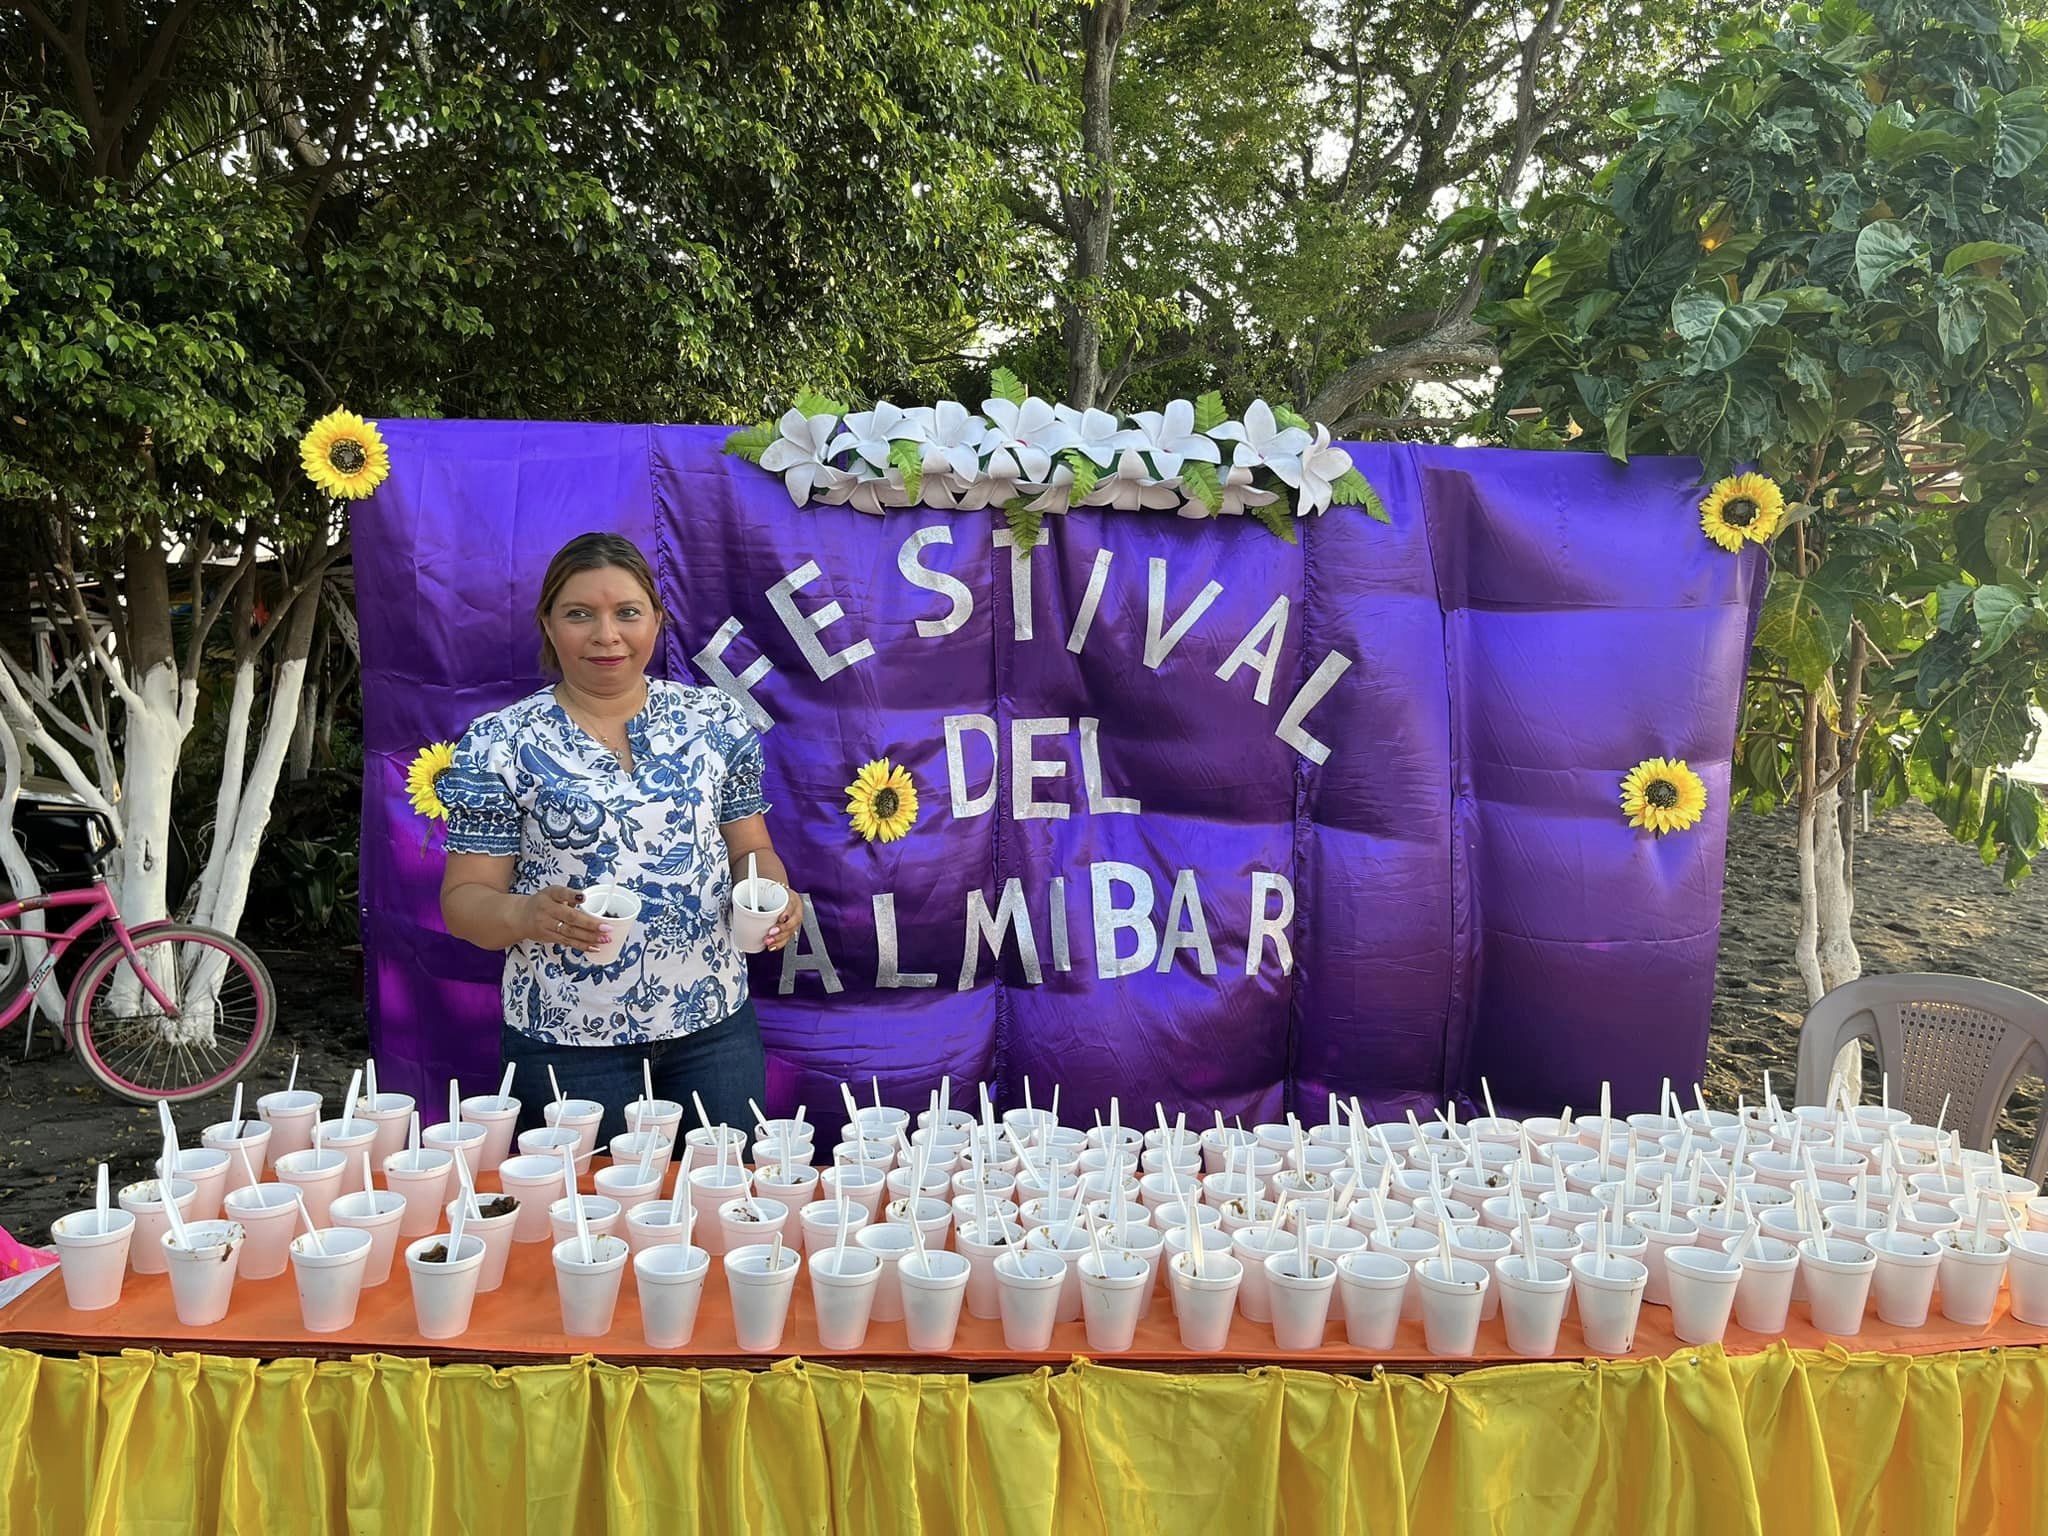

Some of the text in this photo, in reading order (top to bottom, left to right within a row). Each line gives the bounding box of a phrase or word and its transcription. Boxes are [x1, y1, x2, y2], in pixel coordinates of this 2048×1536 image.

[691, 525, 1353, 766] FESTIVAL
[943, 713, 1141, 820] DEL
[778, 861, 1296, 994] ALMIBAR
